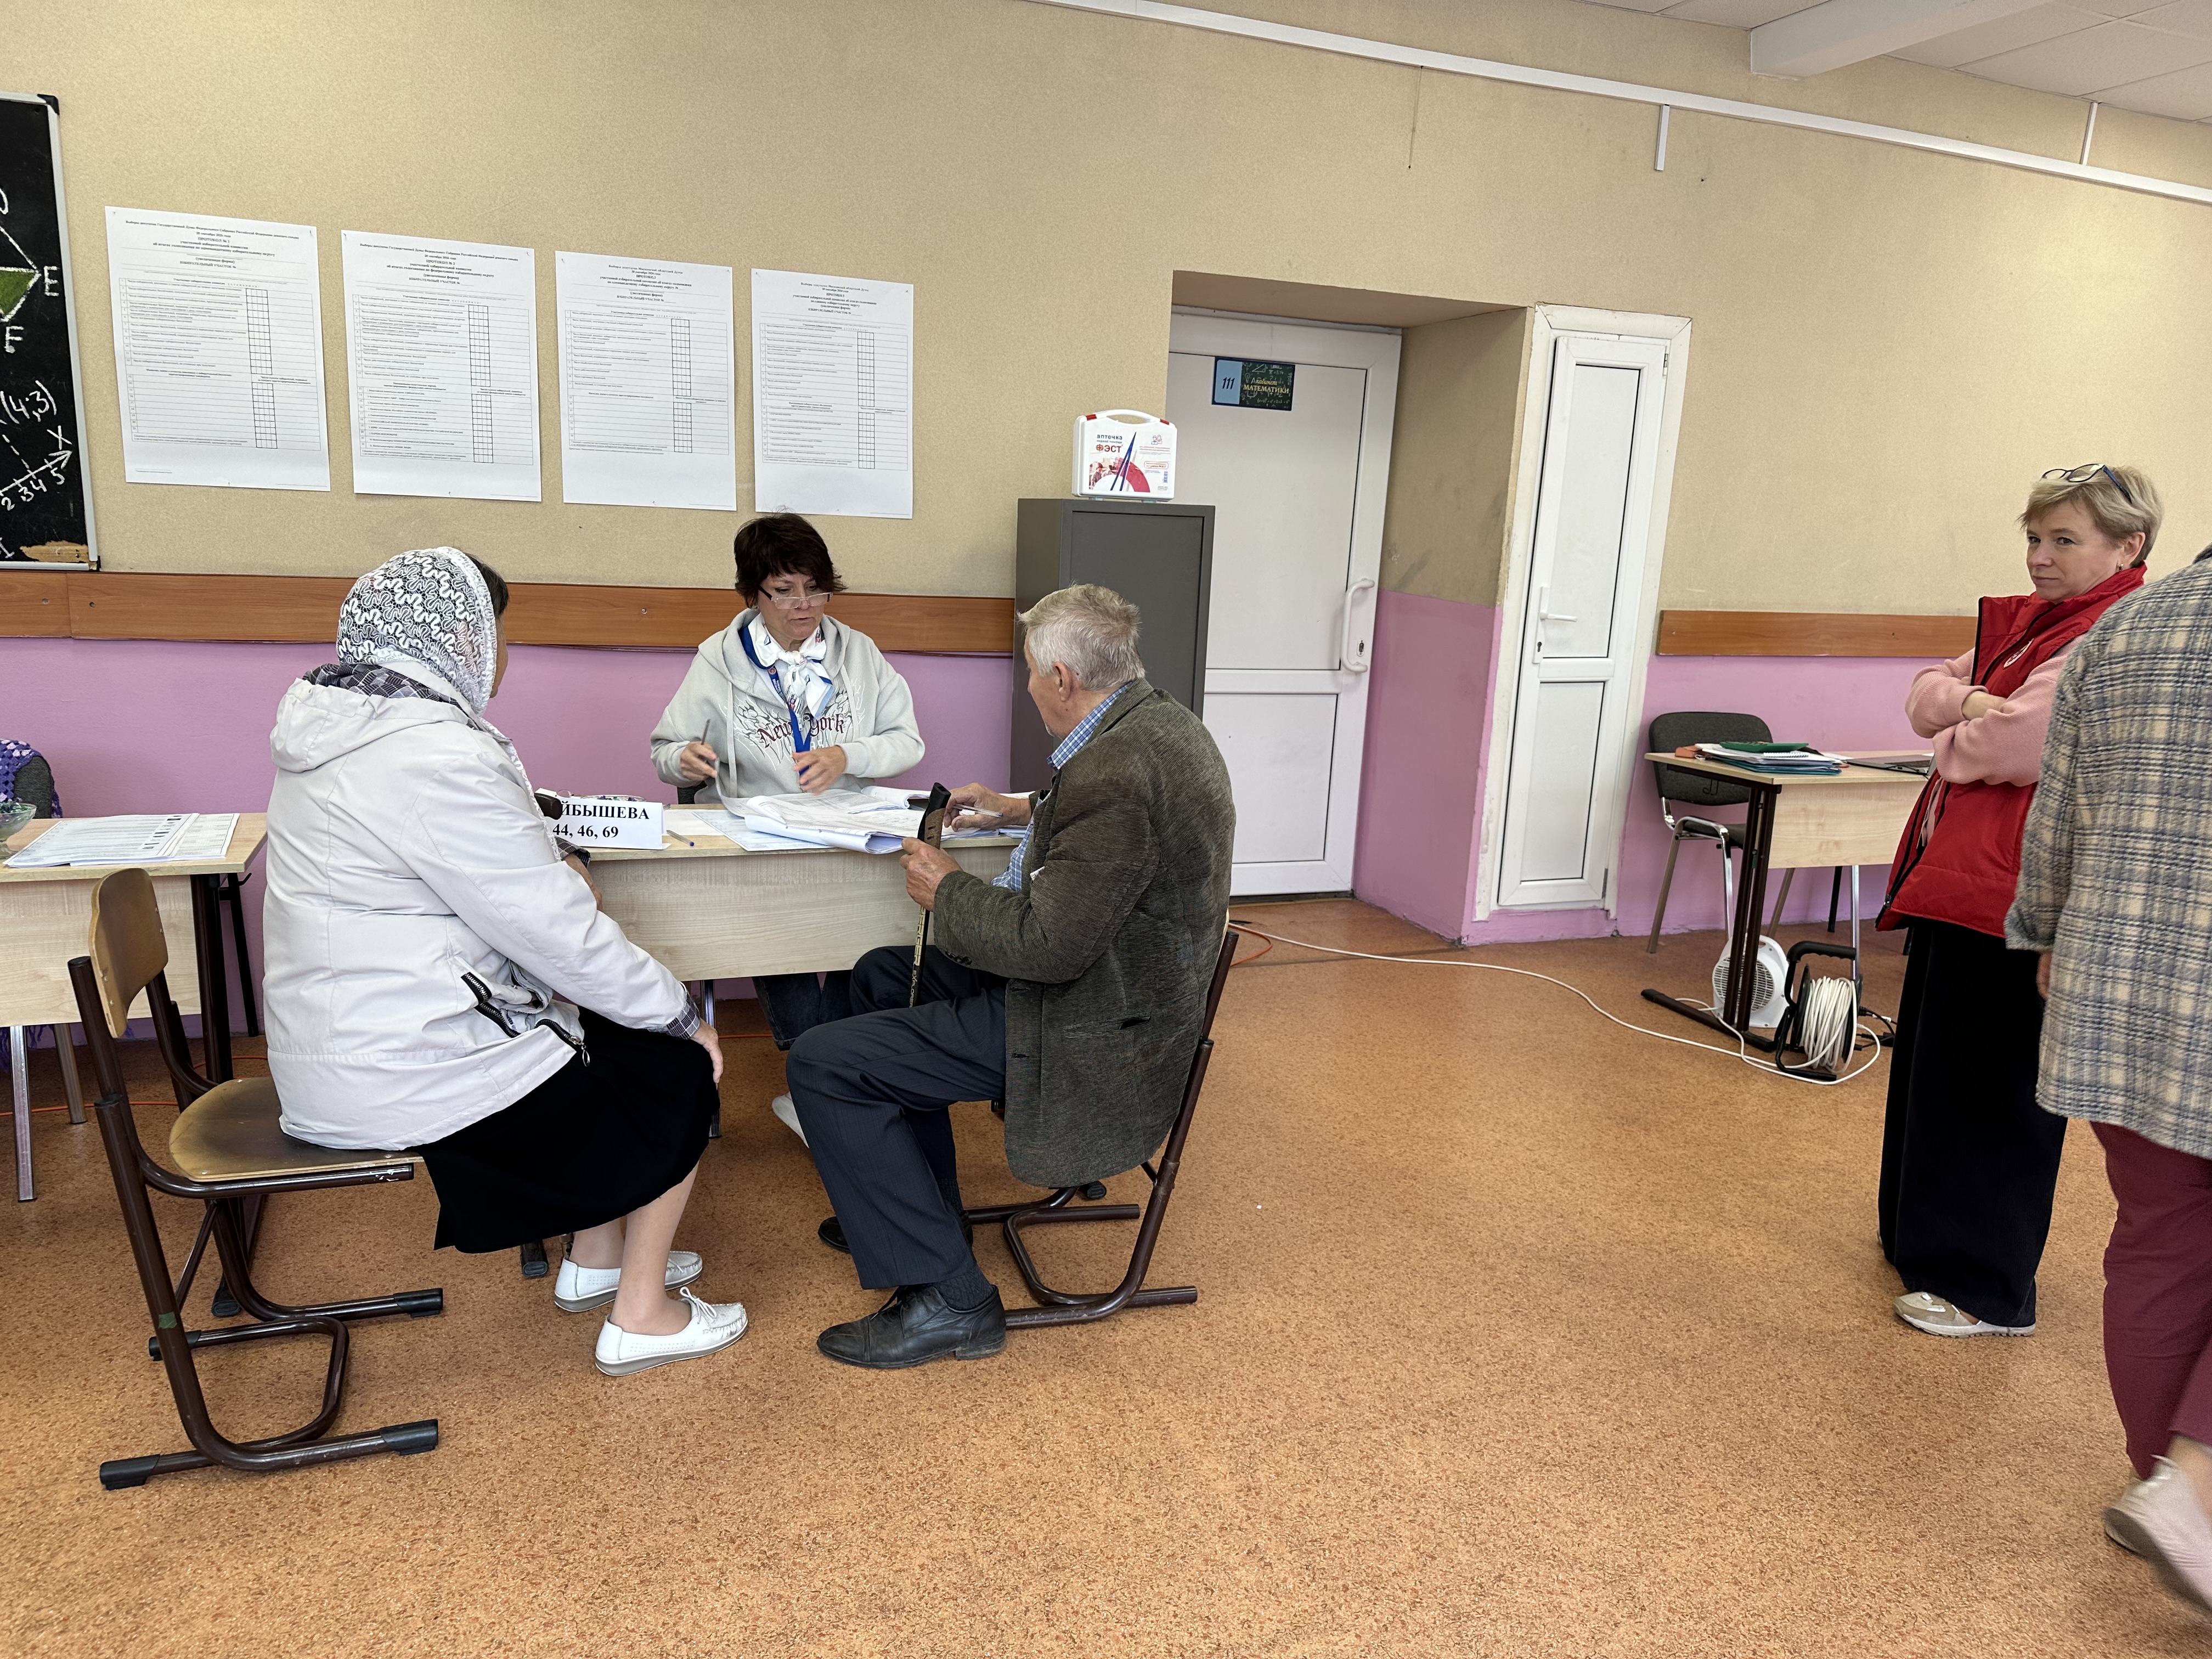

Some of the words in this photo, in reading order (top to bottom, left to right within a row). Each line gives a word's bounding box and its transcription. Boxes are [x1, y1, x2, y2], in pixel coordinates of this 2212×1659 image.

[1222, 377, 1235, 390] 111
[1243, 384, 1289, 394] МАТЕМАТИКИ
[18, 487, 34, 501] 3
[30, 479, 47, 492] 4
[50, 467, 65, 485] 5
[561, 800, 650, 820] ЙБЫШЕВА
[552, 823, 573, 838] 44,
[577, 825, 598, 839] 46,
[602, 826, 619, 838] 69
